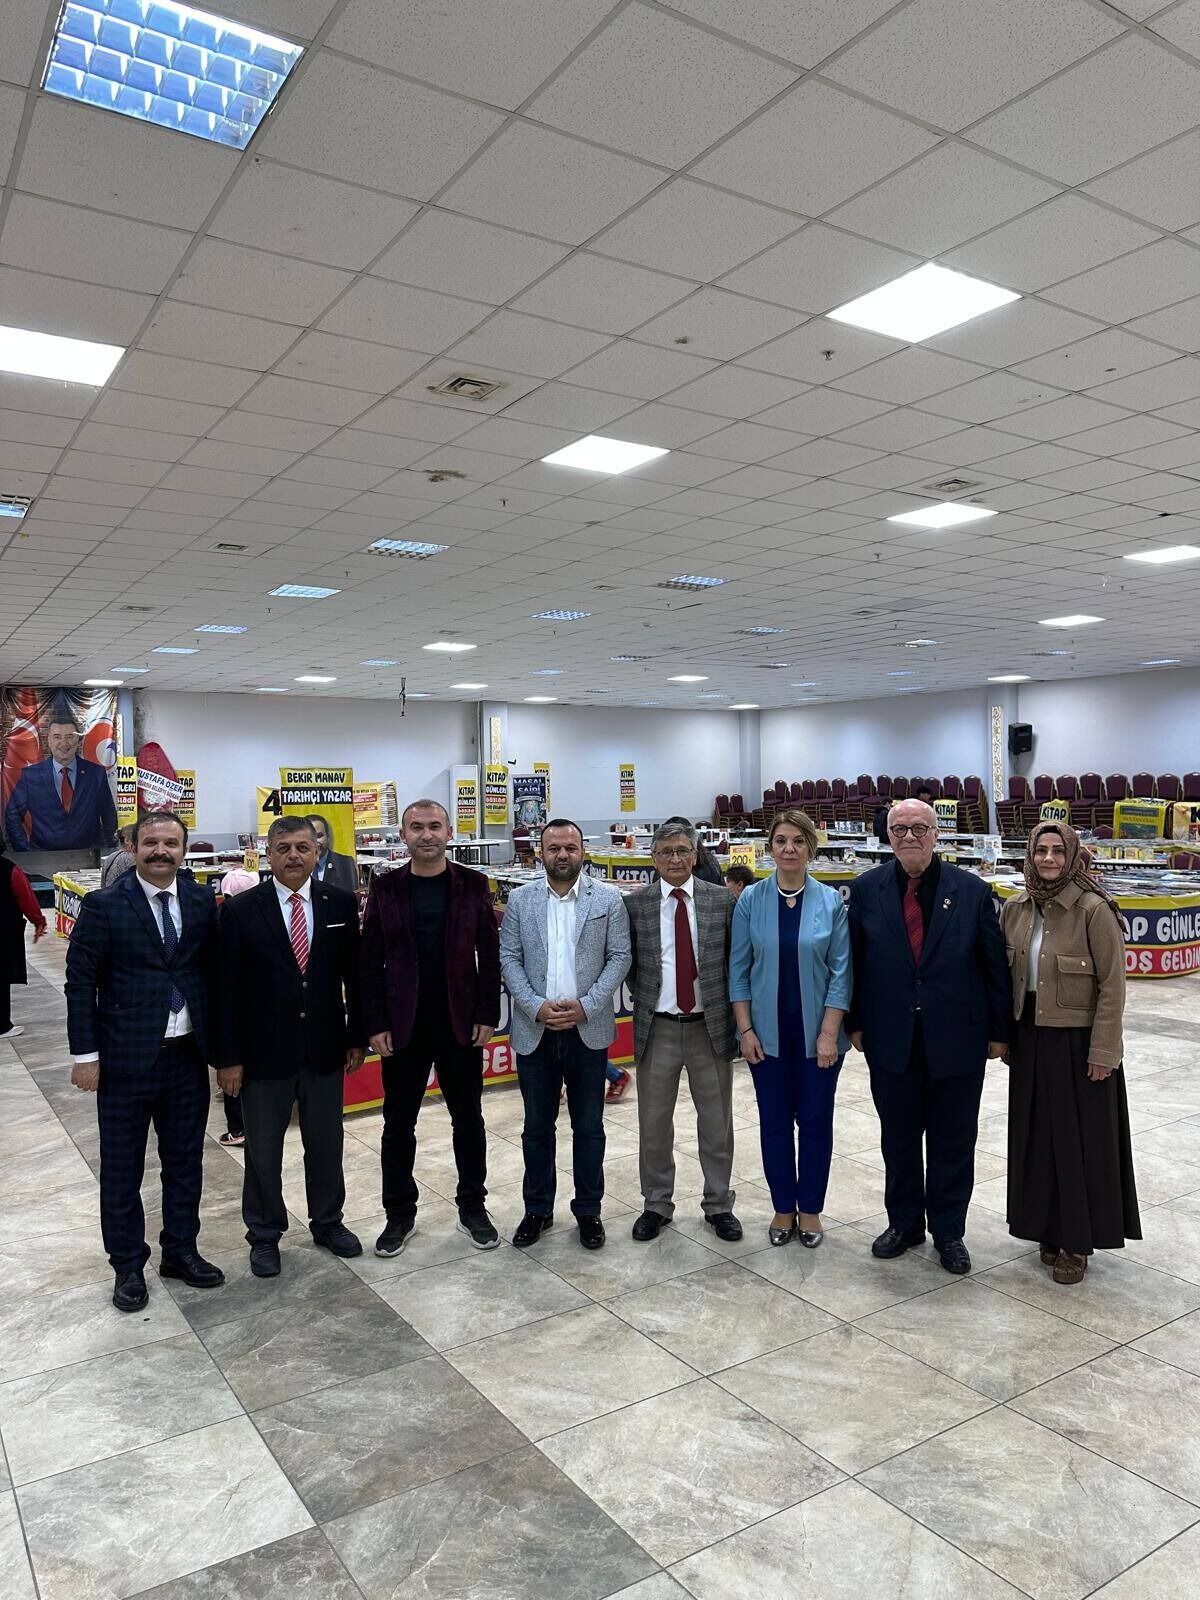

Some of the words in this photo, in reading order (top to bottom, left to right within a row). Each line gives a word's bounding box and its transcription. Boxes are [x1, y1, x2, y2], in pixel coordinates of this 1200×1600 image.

[117, 766, 134, 778] TAP
[287, 772, 312, 783] BEKİR
[315, 772, 345, 783] MANAV
[486, 772, 506, 783] KİTAP
[282, 790, 320, 804] TARİHÇİ
[322, 789, 352, 803] YAZAR
[934, 804, 955, 815] KİTAP
[1041, 806, 1067, 820] KİTAP
[1125, 950, 1153, 974] OŞ
